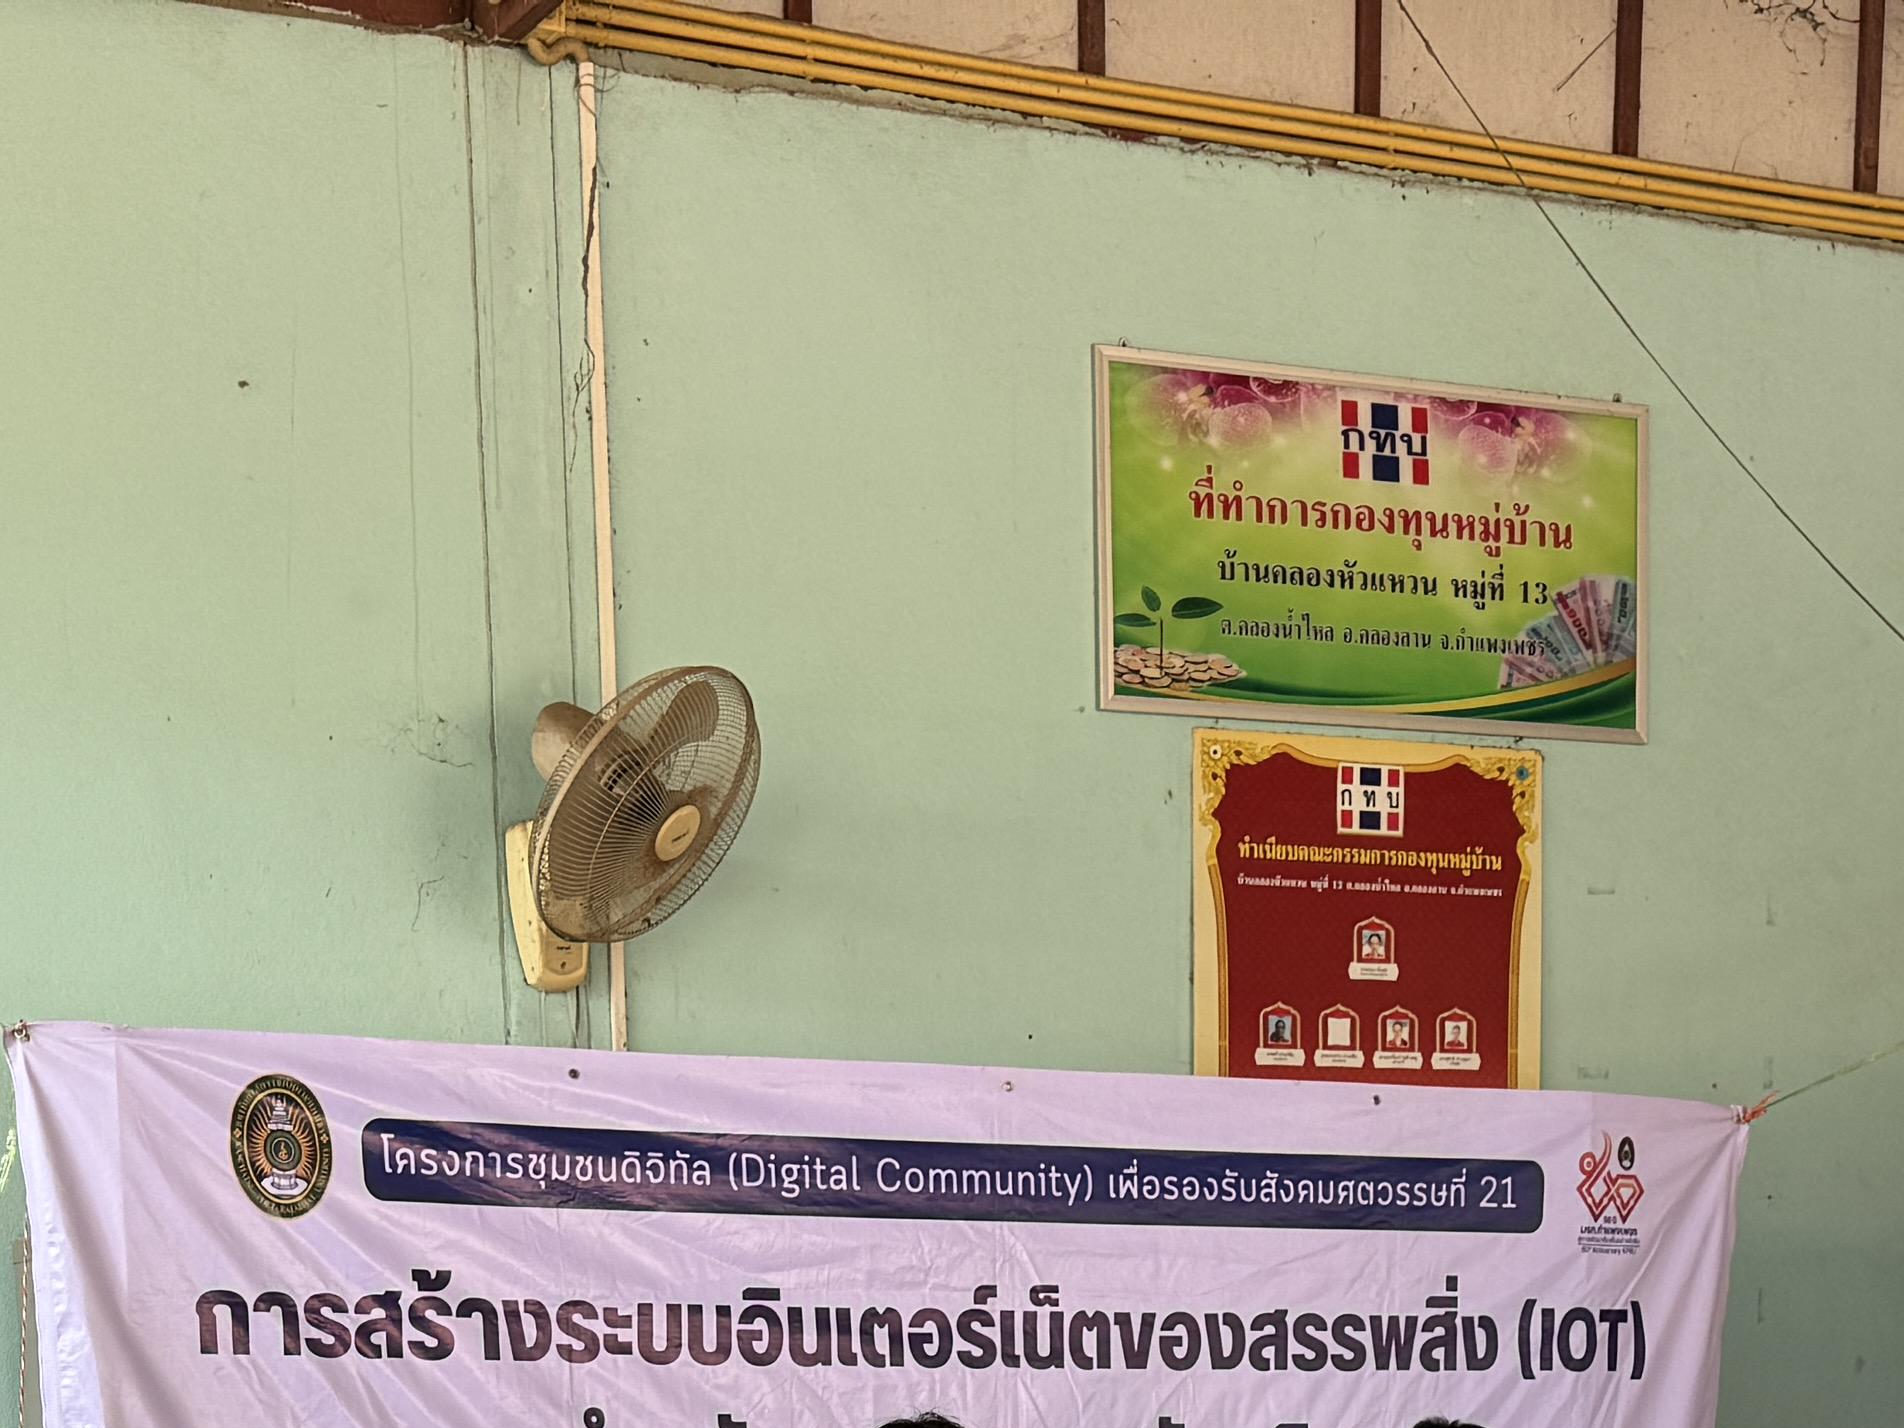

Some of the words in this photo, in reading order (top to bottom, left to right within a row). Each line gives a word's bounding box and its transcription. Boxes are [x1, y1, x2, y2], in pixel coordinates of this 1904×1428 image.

[1188, 464, 1573, 558] ที่ทำการกองทุนหมู่บ้าน
[1217, 550, 1438, 598] บ้านคลองหัวแหวน
[1451, 563, 1505, 612] หมู่ที่
[1518, 580, 1549, 606] 13
[1238, 836, 1502, 876] ทำเนียบคณะกรรมการกองทุนหมู่บ้าน
[380, 1132, 712, 1191] โครงการชุมชนดิจิทัล
[728, 1152, 862, 1197] (Digital
[876, 1156, 1093, 1208] Community)
[1107, 1161, 1469, 1211] เพื่อรองรับสังคมศตวรรษที่
[1478, 1176, 1518, 1209] 21
[196, 1268, 1497, 1372] การสร้างระบบอินเตอร์เน็ตของสรรพสิ่ง
[1519, 1298, 1648, 1381] (IOT)
